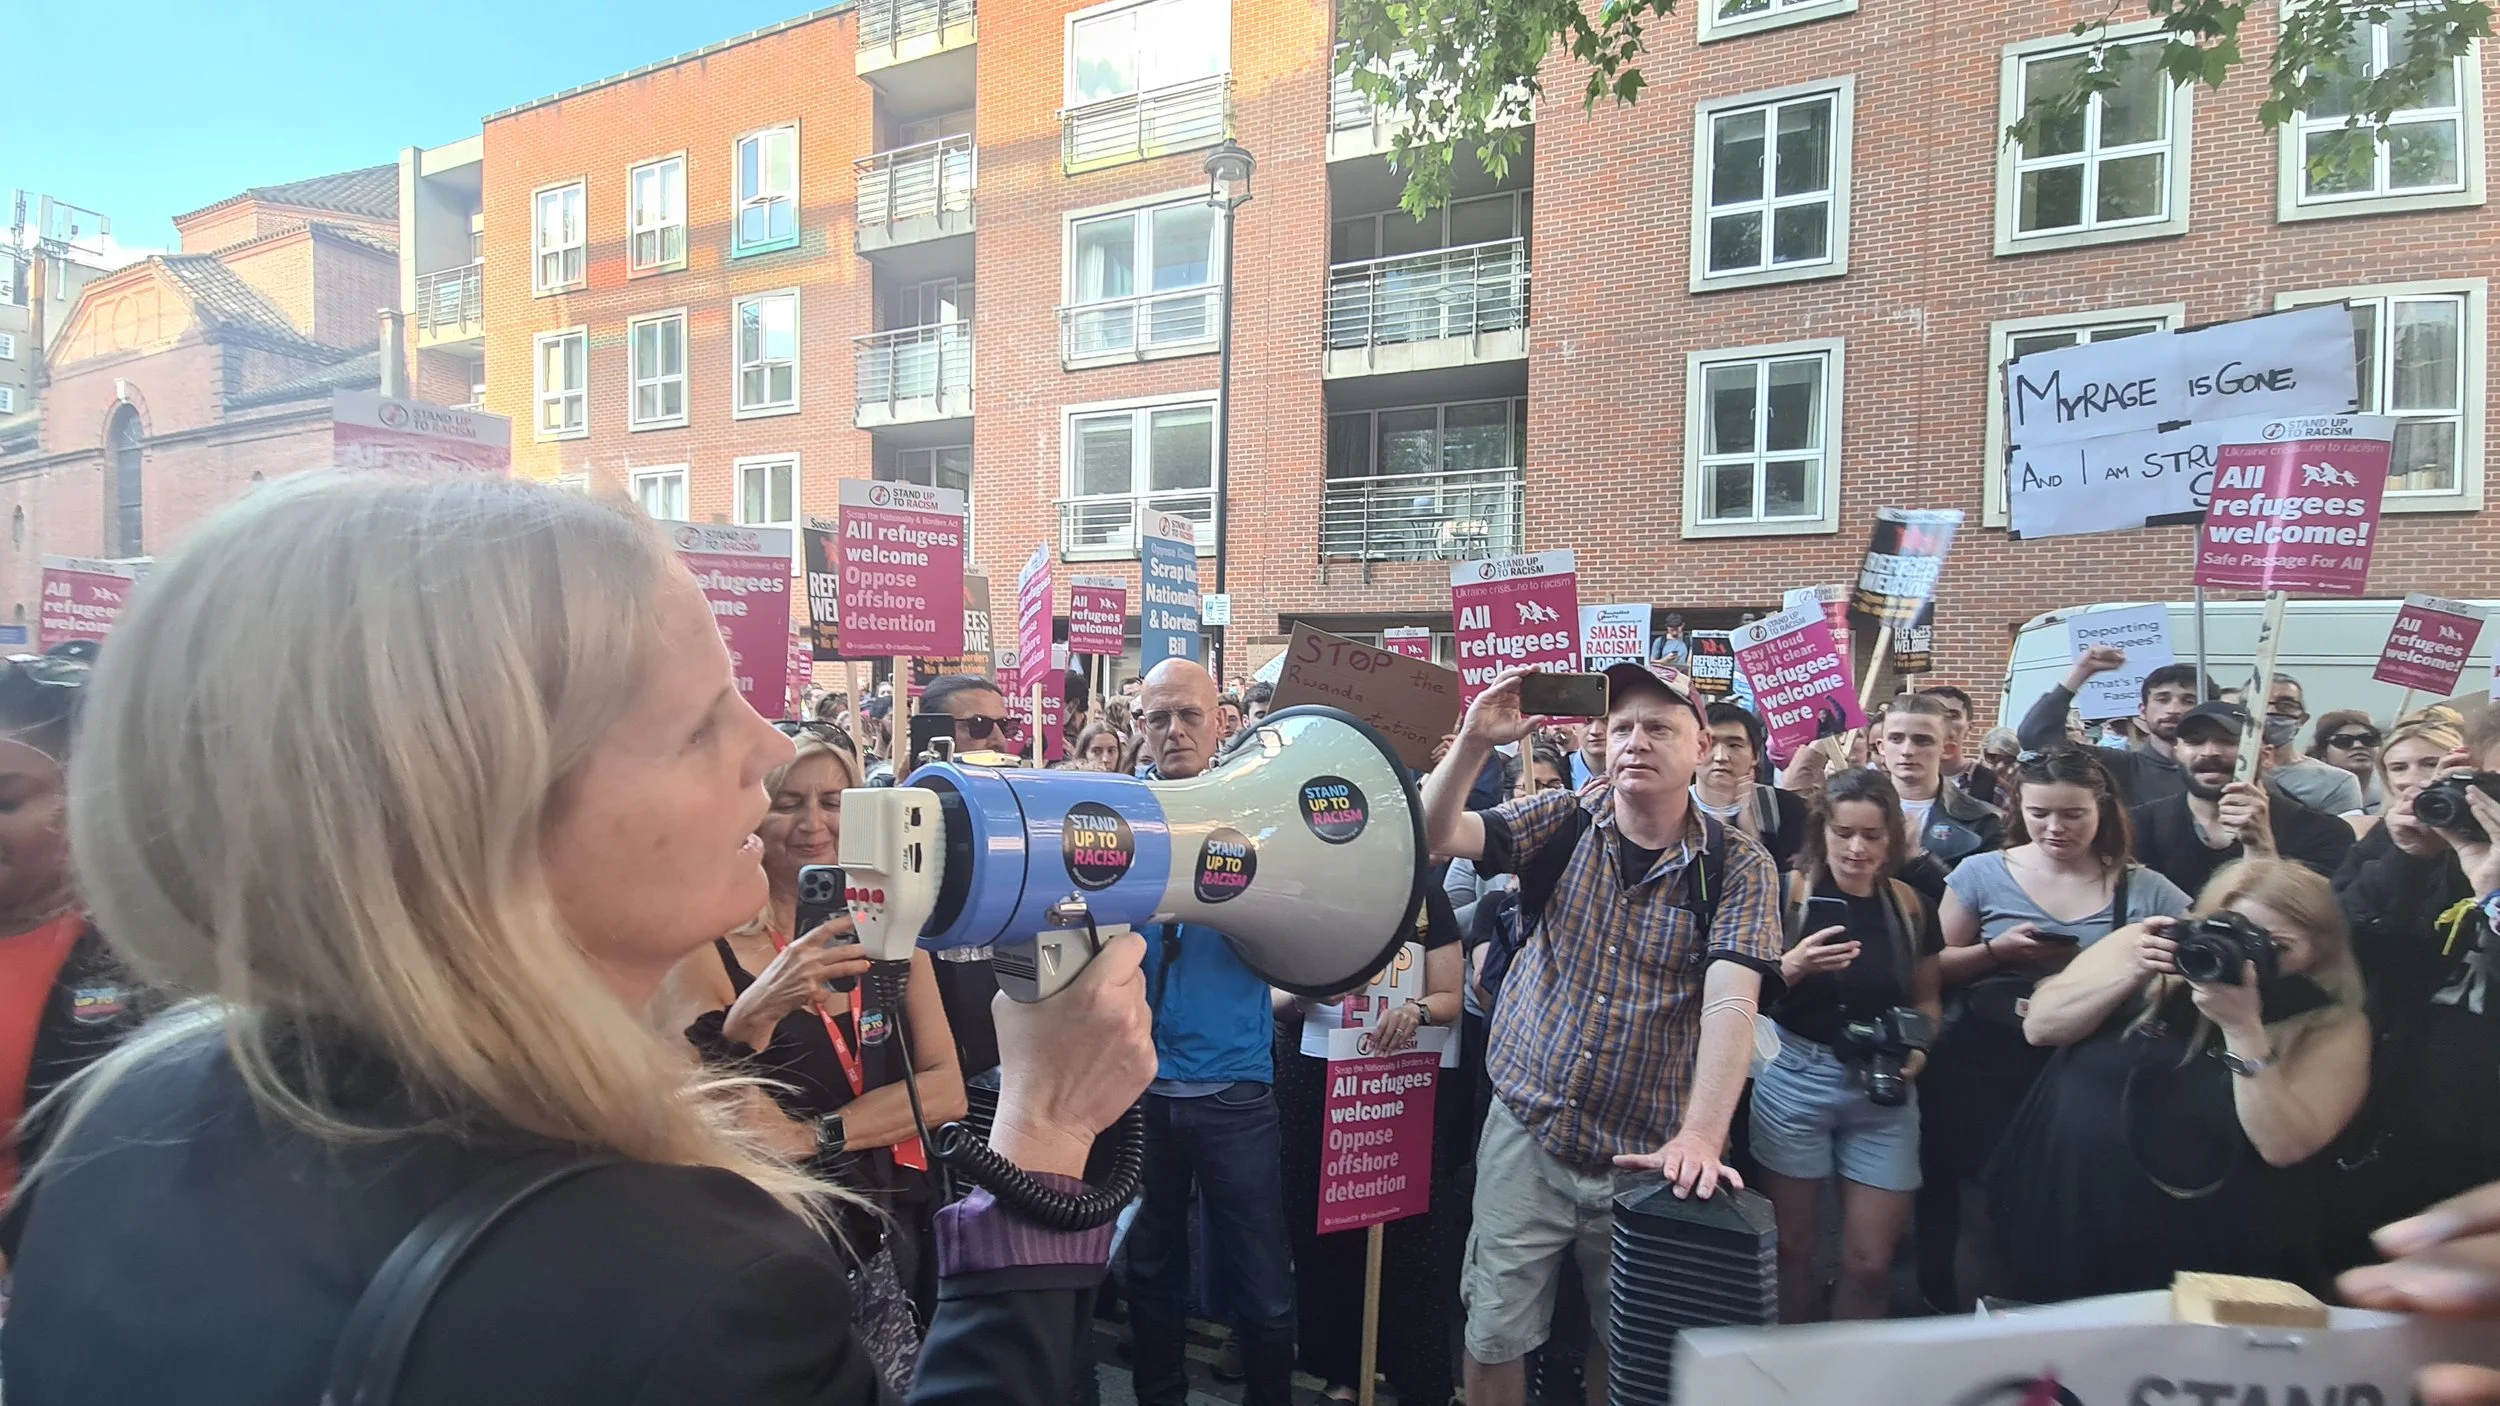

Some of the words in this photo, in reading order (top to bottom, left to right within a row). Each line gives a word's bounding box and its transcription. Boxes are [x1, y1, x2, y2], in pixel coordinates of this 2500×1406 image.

[2188, 378, 2212, 397] IS
[412, 408, 453, 423] STAND
[2288, 418, 2328, 430] STAND
[2330, 418, 2348, 428] UP
[414, 420, 429, 431] TO
[2287, 428, 2302, 438] TO
[2304, 427, 2353, 437] RACISM
[2021, 461, 2062, 492] AND
[2104, 465, 2129, 480] AM
[2141, 444, 2219, 478] STRU
[2217, 465, 2266, 489] All
[893, 488, 921, 499] STAND
[923, 492, 936, 501] UP
[894, 497, 905, 507] TO
[906, 499, 939, 511] RACISM
[2212, 492, 2365, 521] refugees
[846, 521, 873, 540] All
[878, 524, 959, 548] refugees
[2208, 520, 2370, 547] welcome!
[846, 545, 929, 566] welcome
[1497, 558, 1525, 571] STAND
[1526, 556, 1539, 566] UP
[2202, 552, 2237, 566] Safe
[2240, 554, 2308, 569] Passage
[2310, 555, 2337, 569] For
[2340, 557, 2363, 571] All
[845, 566, 917, 590] Oppose
[1150, 557, 1184, 584] Scrap
[1510, 565, 1545, 576] RACISM
[44, 581, 73, 598] All
[698, 569, 784, 596] efugees
[1455, 586, 1488, 599] Ukraine
[1540, 578, 1571, 589] racism
[845, 590, 926, 610] offshore
[1072, 595, 1088, 608] All
[42, 616, 113, 633] welcom
[845, 611, 936, 633] detention
[1071, 608, 1121, 624] refugees
[1149, 608, 1160, 630] &
[1161, 610, 1198, 632] Borders
[1458, 604, 1492, 631] All
[1766, 615, 1789, 628] STAND
[1789, 611, 1799, 620] UP
[2396, 617, 2423, 632] All
[1071, 621, 1123, 636] welcome!
[1590, 624, 1638, 640] SMASH
[1769, 627, 1779, 636] TO
[1780, 617, 1807, 634] RACISM
[2077, 621, 2160, 639] Deporting
[1168, 636, 1187, 656] Bill
[1460, 631, 1570, 659] refugees
[1586, 640, 1642, 655] RACISM!
[1742, 647, 1764, 662] Say
[1779, 632, 1805, 650] loud
[2389, 633, 2464, 657] refugees
[1296, 634, 1394, 674] STOP
[1409, 670, 1447, 695] the
[1692, 655, 1734, 668] REFUGEES
[1747, 660, 1769, 674] Say
[2385, 648, 2464, 673] welcome!
[1692, 666, 1733, 679] WELCOME
[1751, 652, 1840, 693] Refugees
[1287, 664, 1364, 703] Rwanda
[1760, 673, 1845, 710] welcome
[2087, 678, 2130, 689] That's
[1767, 705, 1814, 730] here
[1305, 784, 1349, 799] STAND
[1308, 798, 1329, 812] UP
[1329, 796, 1351, 810] TO
[1072, 814, 1118, 832] STAND
[1312, 808, 1364, 826] RACISM
[1073, 830, 1095, 848] UP
[1097, 831, 1118, 849] TO
[1207, 840, 1246, 858] STAND
[1074, 848, 1127, 867] RACISM
[1206, 854, 1224, 871] UP
[1225, 857, 1242, 873] TO
[1201, 870, 1248, 888] RACISM
[860, 1012, 883, 1025] STAND
[861, 1024, 871, 1032] UP
[873, 1020, 883, 1029] TO
[1354, 1064, 1364, 1073] the
[1401, 1059, 1424, 1068] Borders
[1425, 1057, 1436, 1066] Act
[1332, 1075, 1357, 1098] All
[1361, 1072, 1433, 1096] refugees
[1330, 1100, 1405, 1124] welcome
[1329, 1127, 1393, 1154] Oppose
[1327, 1151, 1399, 1177] offshore
[1325, 1174, 1406, 1204] detention
